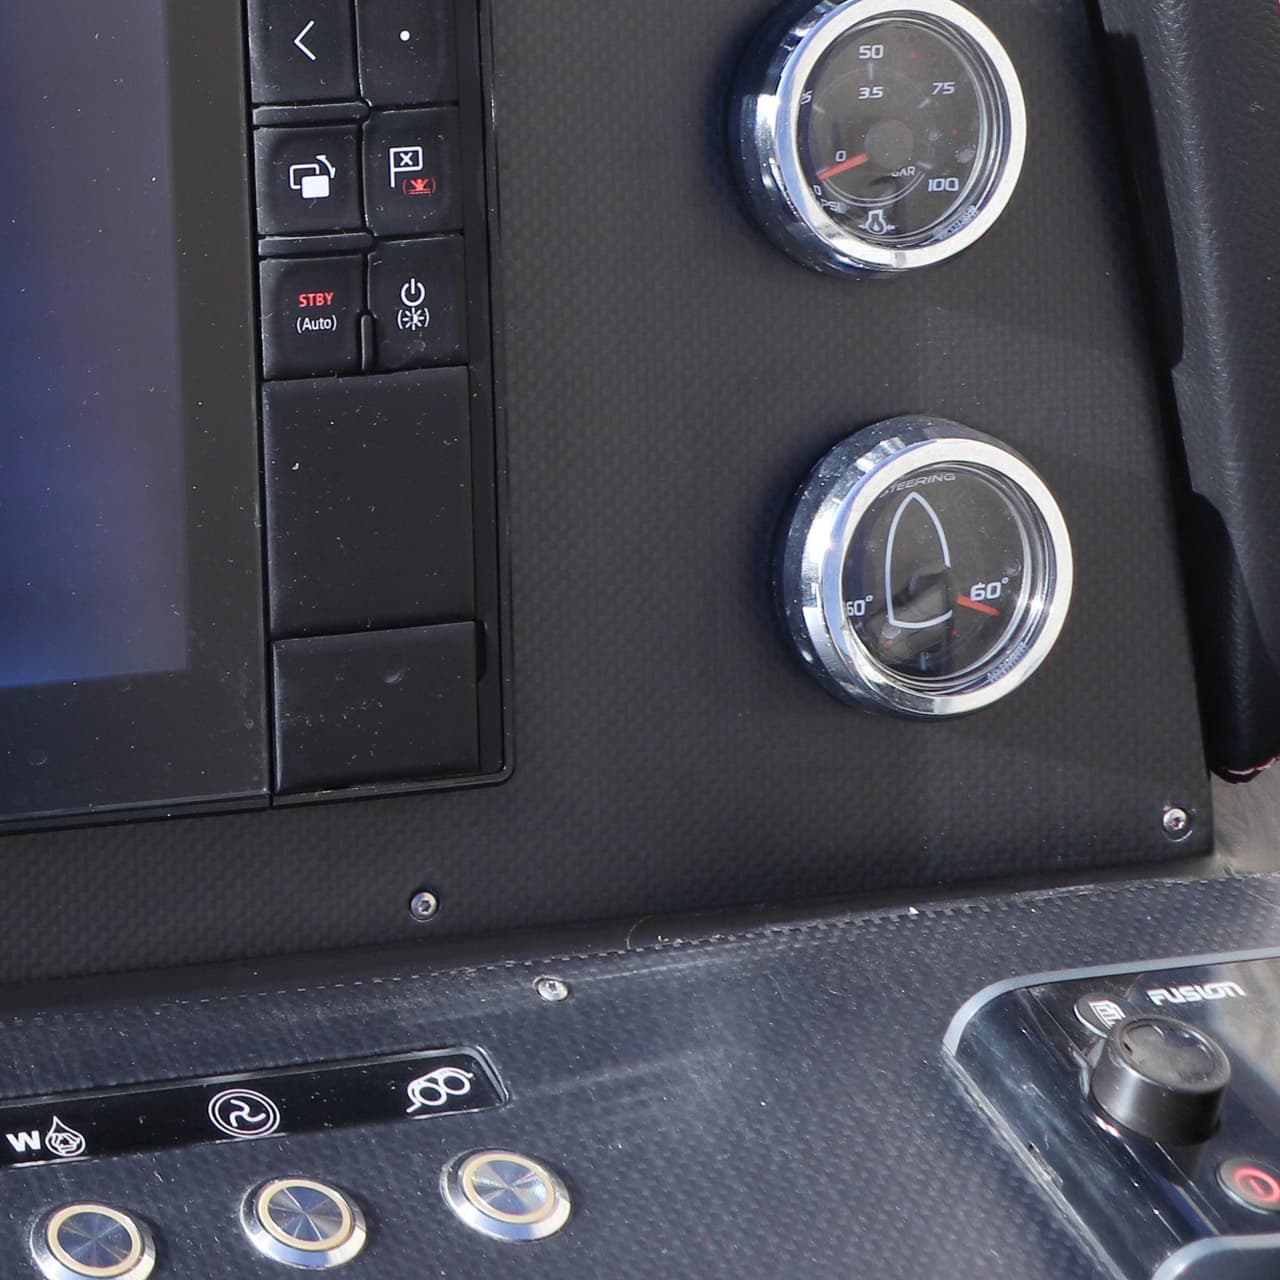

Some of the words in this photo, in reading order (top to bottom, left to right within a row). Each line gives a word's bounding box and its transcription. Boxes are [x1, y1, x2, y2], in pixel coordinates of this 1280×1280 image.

[858, 44, 884, 59] 50
[858, 87, 884, 100] 3.5
[932, 82, 956, 95] 75
[836, 151, 846, 162] 0
[927, 177, 959, 192] 100
[298, 292, 334, 307] STBY
[296, 314, 337, 333] (Auto)
[970, 577, 1009, 601] 60°
[1146, 981, 1247, 1007] FUSION
[5, 1130, 41, 1152] W
